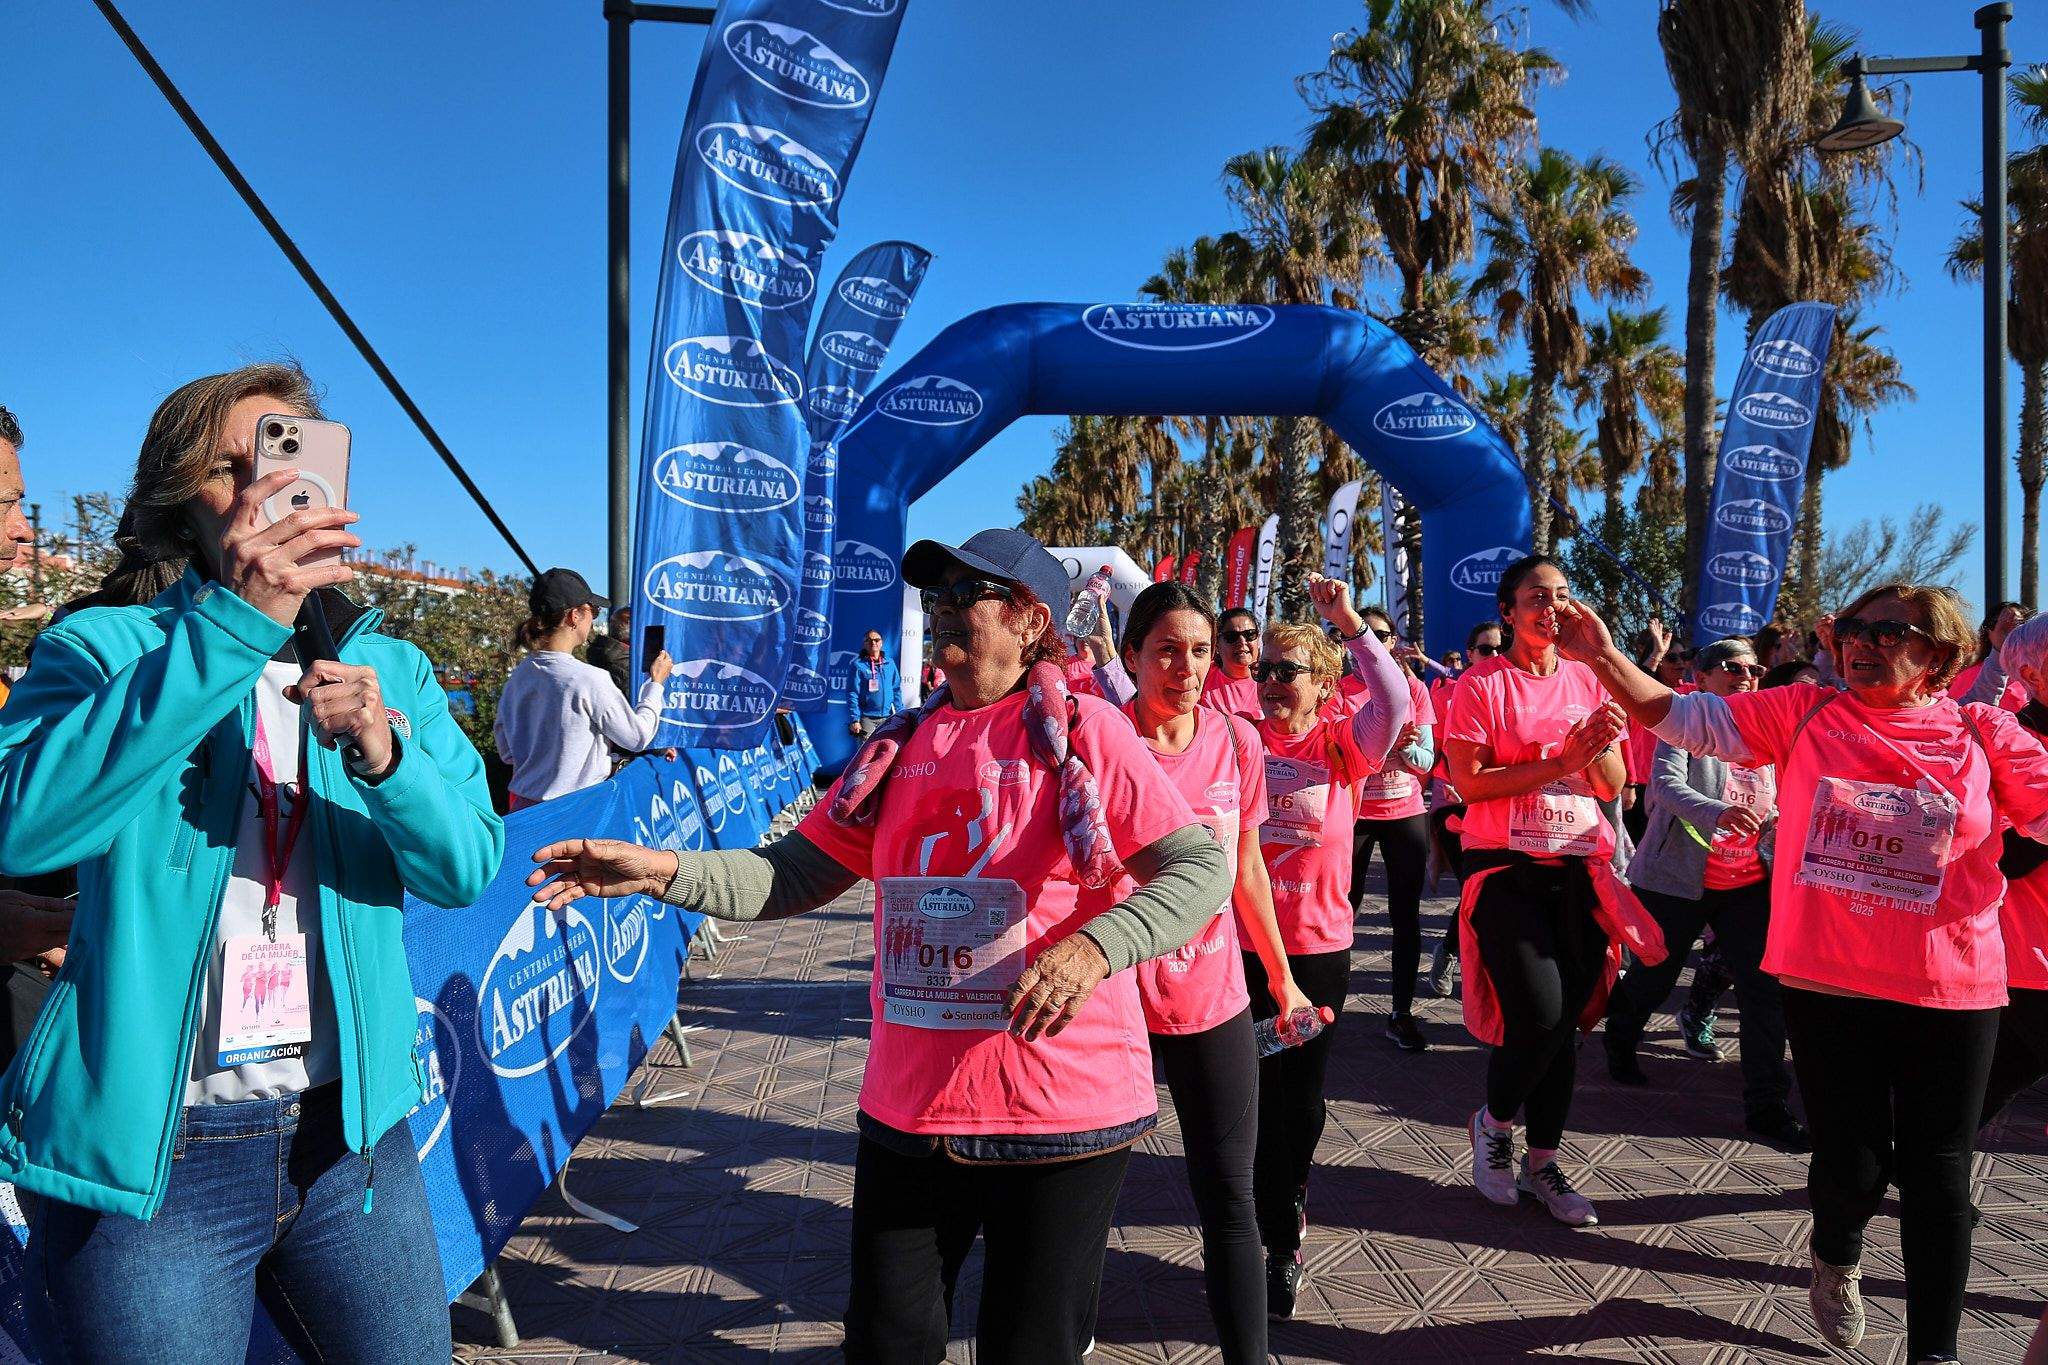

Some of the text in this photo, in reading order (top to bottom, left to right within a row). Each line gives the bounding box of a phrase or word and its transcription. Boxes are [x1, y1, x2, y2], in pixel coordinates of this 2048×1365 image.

[733, 30, 857, 103] ASTURIANA
[704, 133, 828, 199] ASTURIANA
[686, 242, 803, 298] ASTURIANA
[1098, 306, 1263, 330] ASTURIANA
[673, 350, 792, 395] ASTURIANA
[884, 394, 974, 415] ASTURIANA
[1741, 402, 1805, 424] ASTURIANA
[1383, 411, 1472, 429] ASTURIANA
[685, 460, 786, 479] CENTRAL LECHERA
[661, 459, 788, 500] ASTURIANA
[676, 570, 723, 583] CENTRAL
[835, 566, 891, 583] URIANA
[652, 571, 780, 607] ASTURIANA
[670, 681, 766, 694] CENTRAL LECHERA
[662, 691, 767, 714] STURIANA
[890, 761, 936, 779] OYSHO
[1269, 793, 1294, 811] 16
[1730, 790, 1756, 804] 016
[1857, 797, 1907, 814] ASTURIANA
[1542, 808, 1575, 823] 016
[1851, 830, 1904, 855] 016
[1858, 853, 1884, 865] 8363
[1819, 857, 1923, 882] CARRERA DE LA MUJER VALENCIA
[1814, 868, 1924, 897] OYSHO Santander
[922, 898, 971, 912] ASTURIANA
[1849, 903, 1874, 918] 2025
[1851, 889, 1868, 903] DE
[1872, 893, 1888, 908] LA
[1890, 895, 1937, 916] MUJER
[241, 949, 299, 961] DE LA MUJER
[250, 943, 291, 953] CARRERA
[918, 943, 973, 970] 016
[508, 931, 587, 990] CENTRAL LECHERA
[1168, 961, 1188, 973] 2025
[926, 975, 952, 987] 8337
[894, 986, 915, 998] CARRERA
[916, 989, 925, 998] DE
[925, 990, 934, 999] LA
[935, 991, 959, 1000] MUJER
[965, 992, 1001, 1001] VALENCIA
[491, 950, 596, 1060] ASTURIANA
[893, 1003, 926, 1019] OYSHO
[225, 1045, 301, 1064] ORGANIZACIÓN
